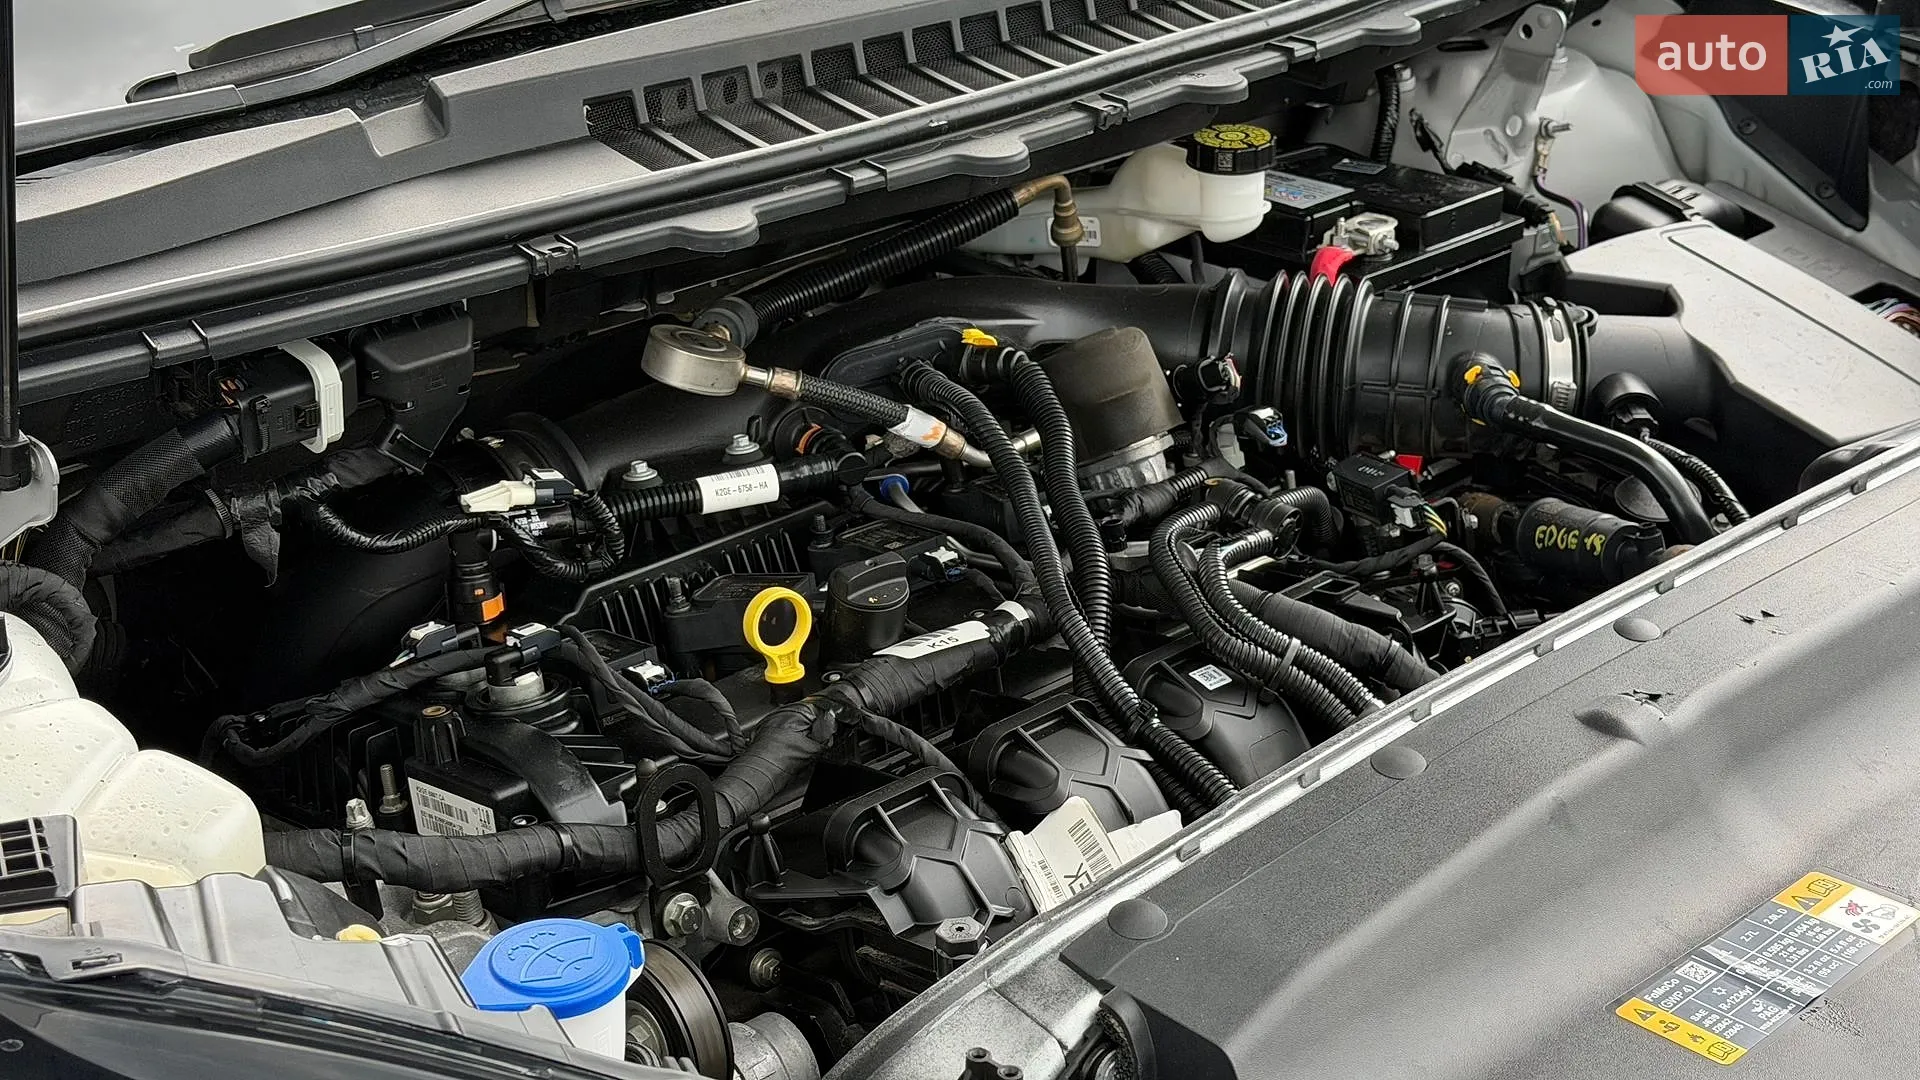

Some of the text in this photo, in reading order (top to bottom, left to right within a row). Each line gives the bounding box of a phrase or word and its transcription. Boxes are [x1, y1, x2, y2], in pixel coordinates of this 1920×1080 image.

[1535, 524, 1580, 550] EDGE
[926, 636, 960, 649] K15
[1643, 977, 1680, 1001] FoMoCo
[1656, 984, 1697, 1010] (GWP 4)
[1757, 1005, 1780, 1020] PAG
